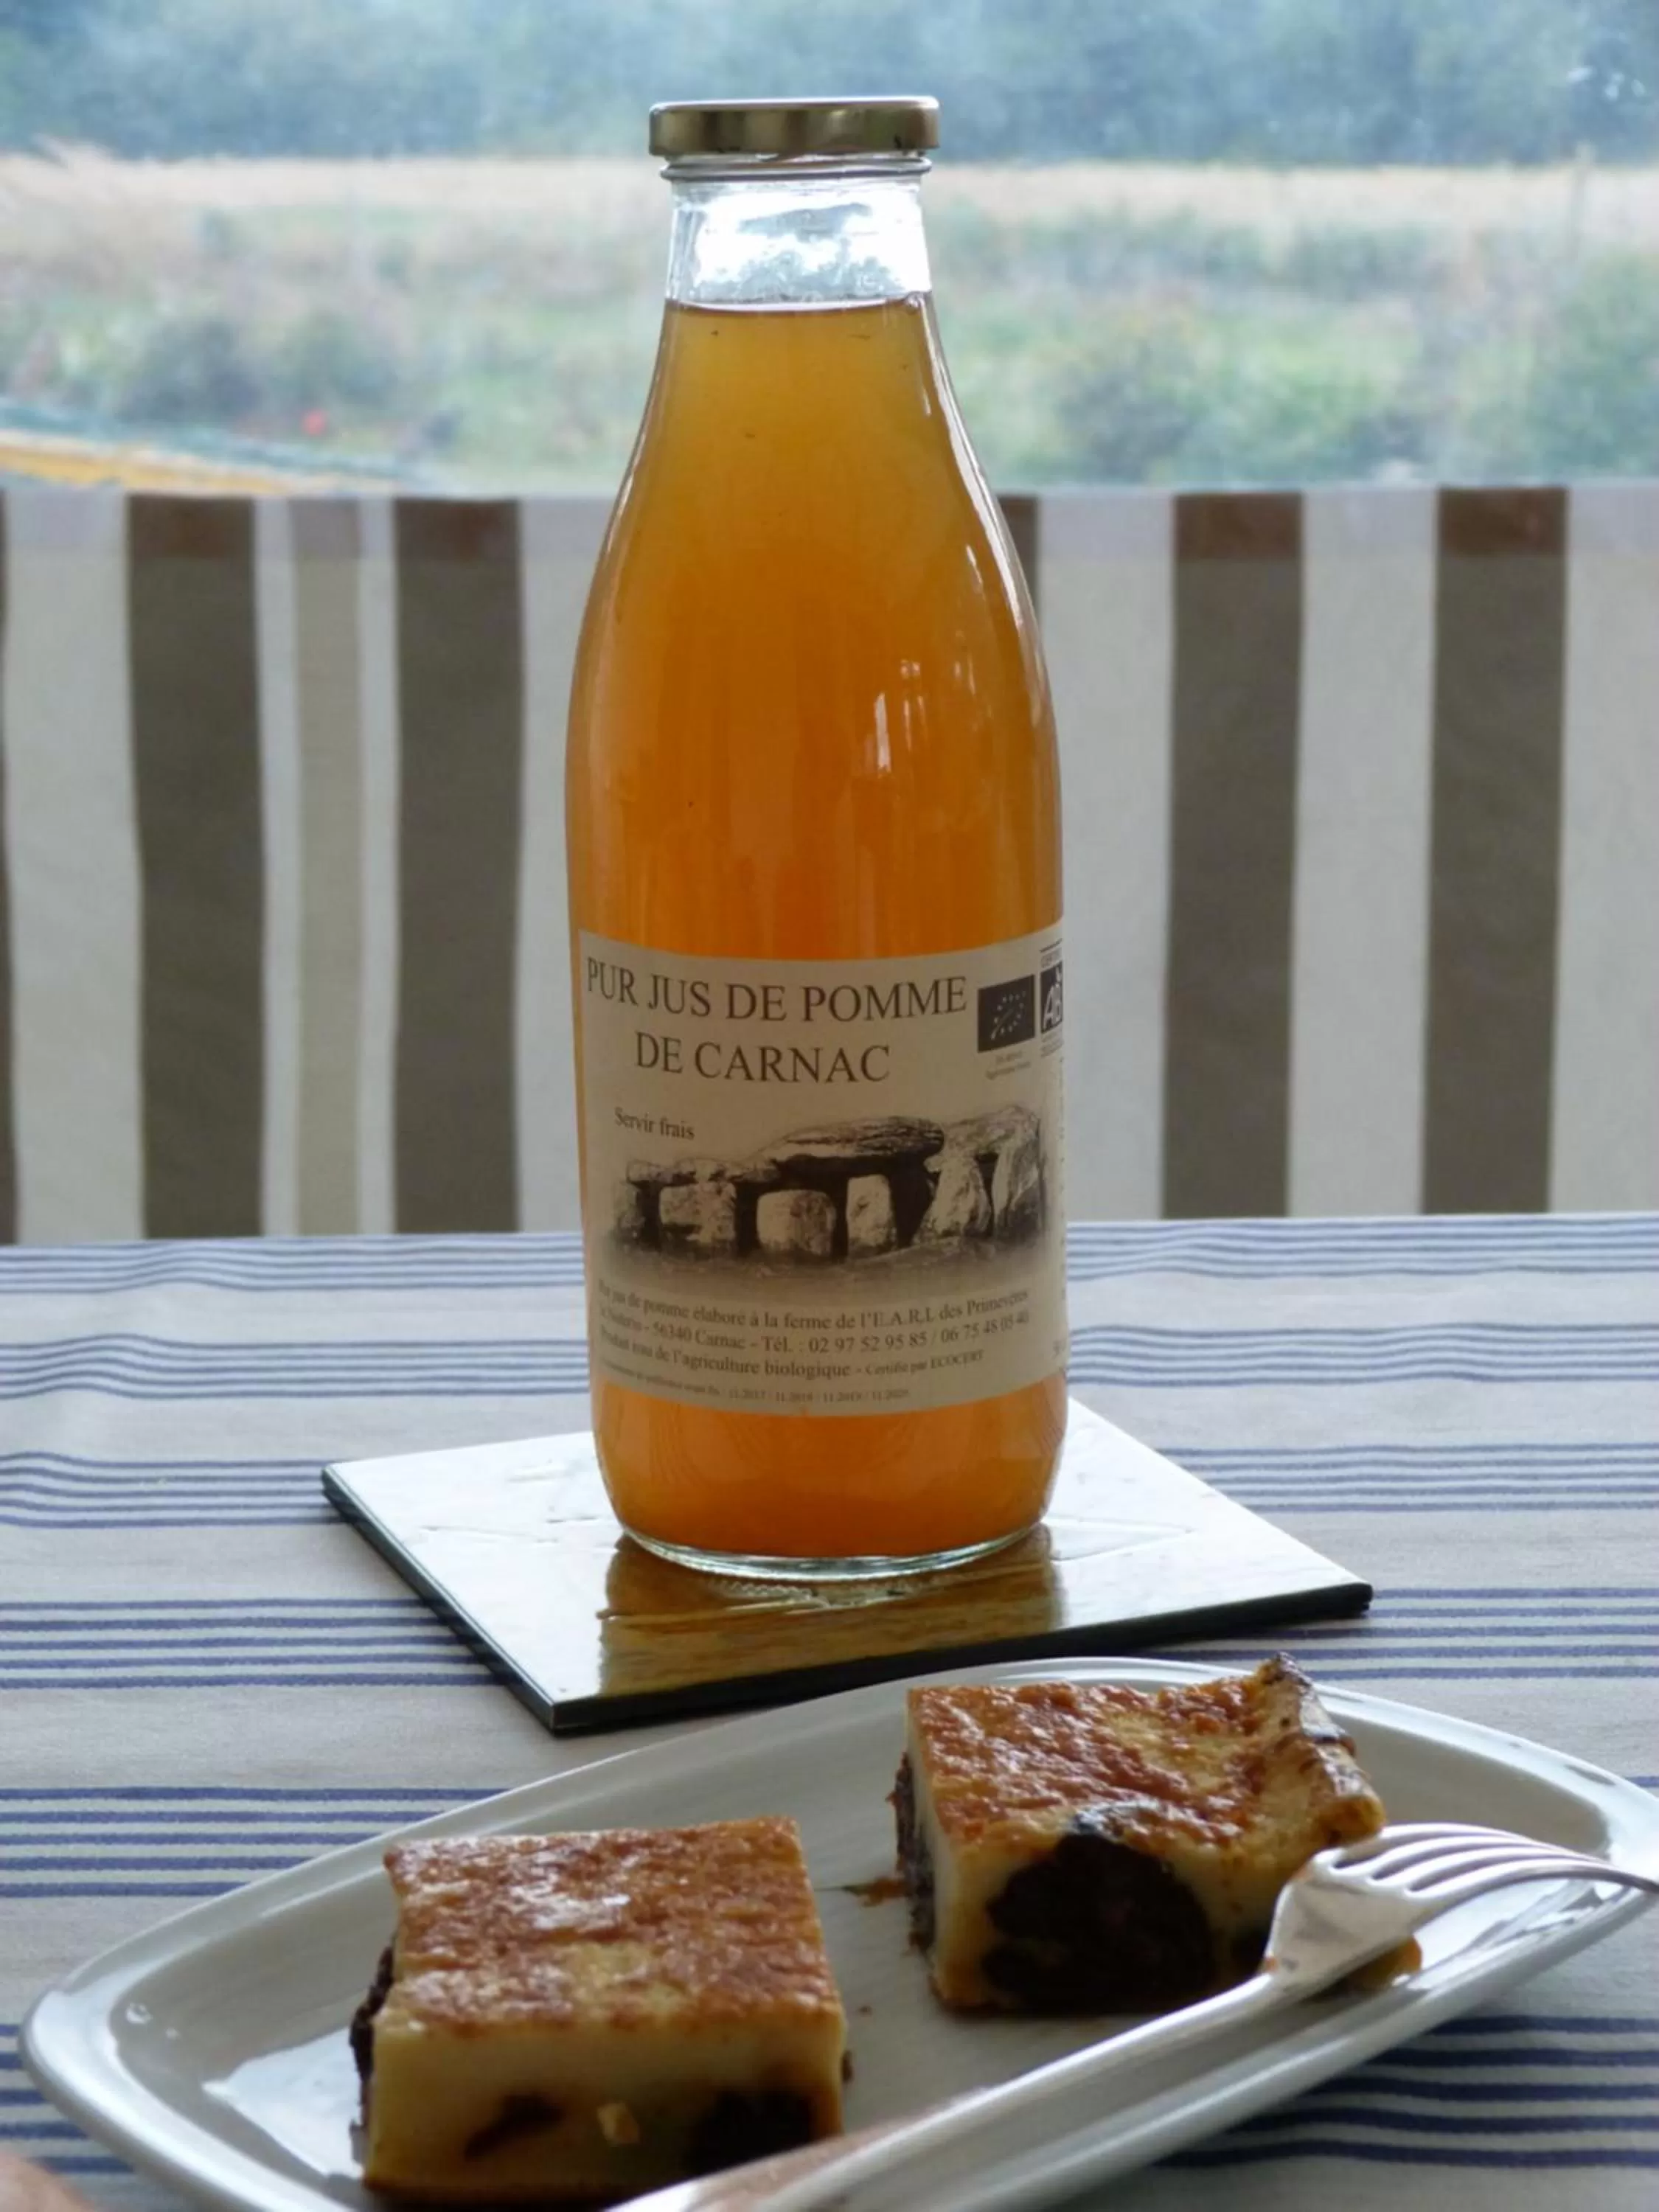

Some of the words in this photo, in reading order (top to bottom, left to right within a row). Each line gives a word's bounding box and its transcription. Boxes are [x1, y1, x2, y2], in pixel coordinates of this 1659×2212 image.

[587, 956, 639, 1006] PUR
[647, 974, 712, 1018] JUS
[726, 983, 787, 1021] DE
[800, 975, 967, 1022] POMME
[635, 1031, 684, 1074] DE
[694, 1040, 889, 1084] CARNAC
[613, 1107, 655, 1133] Servir
[658, 1116, 695, 1141] frais
[764, 1312, 778, 1328] la
[784, 1312, 832, 1329] ferme
[835, 1312, 856, 1329] de
[940, 1303, 963, 1321] des
[695, 1328, 746, 1349] Carnac
[808, 1335, 830, 1354] 02
[835, 1335, 855, 1353] 97
[860, 1335, 880, 1352] 52
[885, 1333, 905, 1351] 95
[909, 1331, 928, 1348] 85
[940, 1326, 959, 1343] 06
[765, 1359, 851, 1380] biologique
